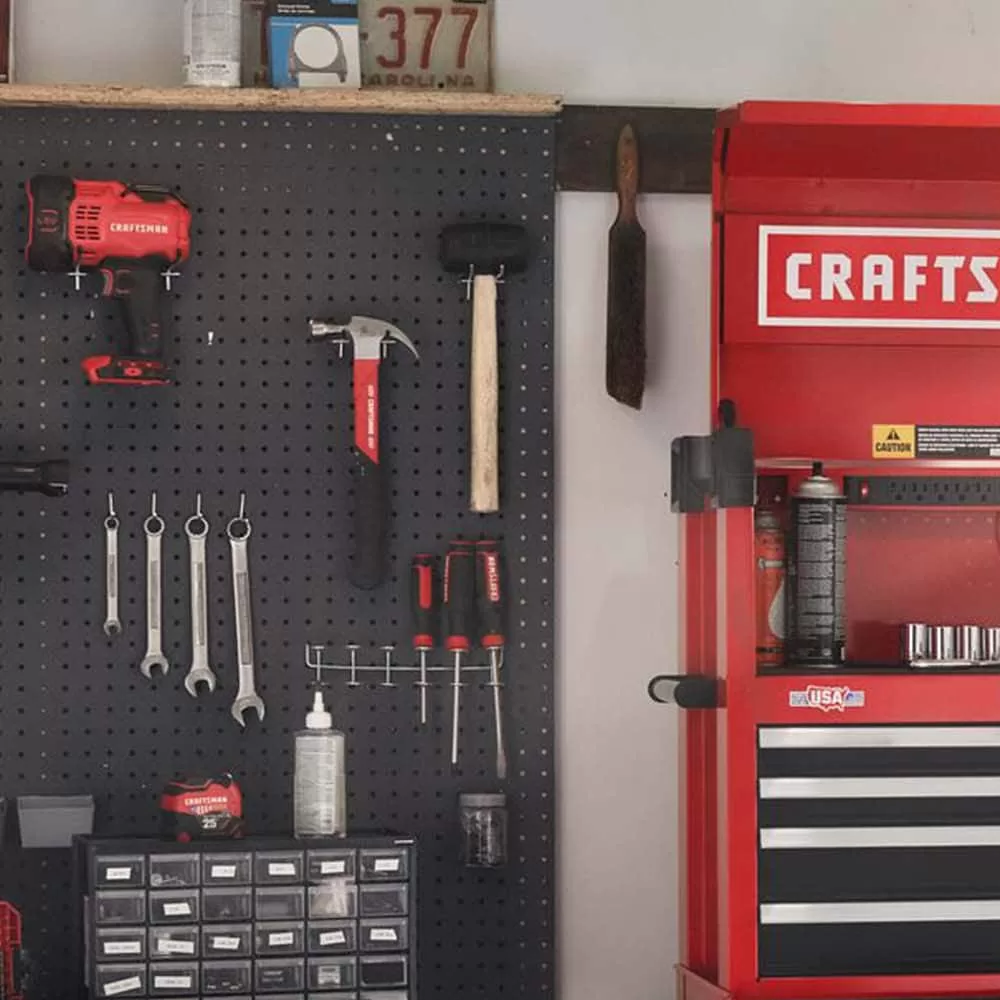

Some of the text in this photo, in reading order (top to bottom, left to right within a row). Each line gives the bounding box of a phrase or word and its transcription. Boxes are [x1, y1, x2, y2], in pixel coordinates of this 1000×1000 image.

[376, 7, 478, 69] 377
[110, 223, 169, 234] CRAFTSMAN
[875, 442, 912, 453] CAUTION
[810, 689, 842, 705] USA
[184, 796, 228, 806] CRAFTSMAN
